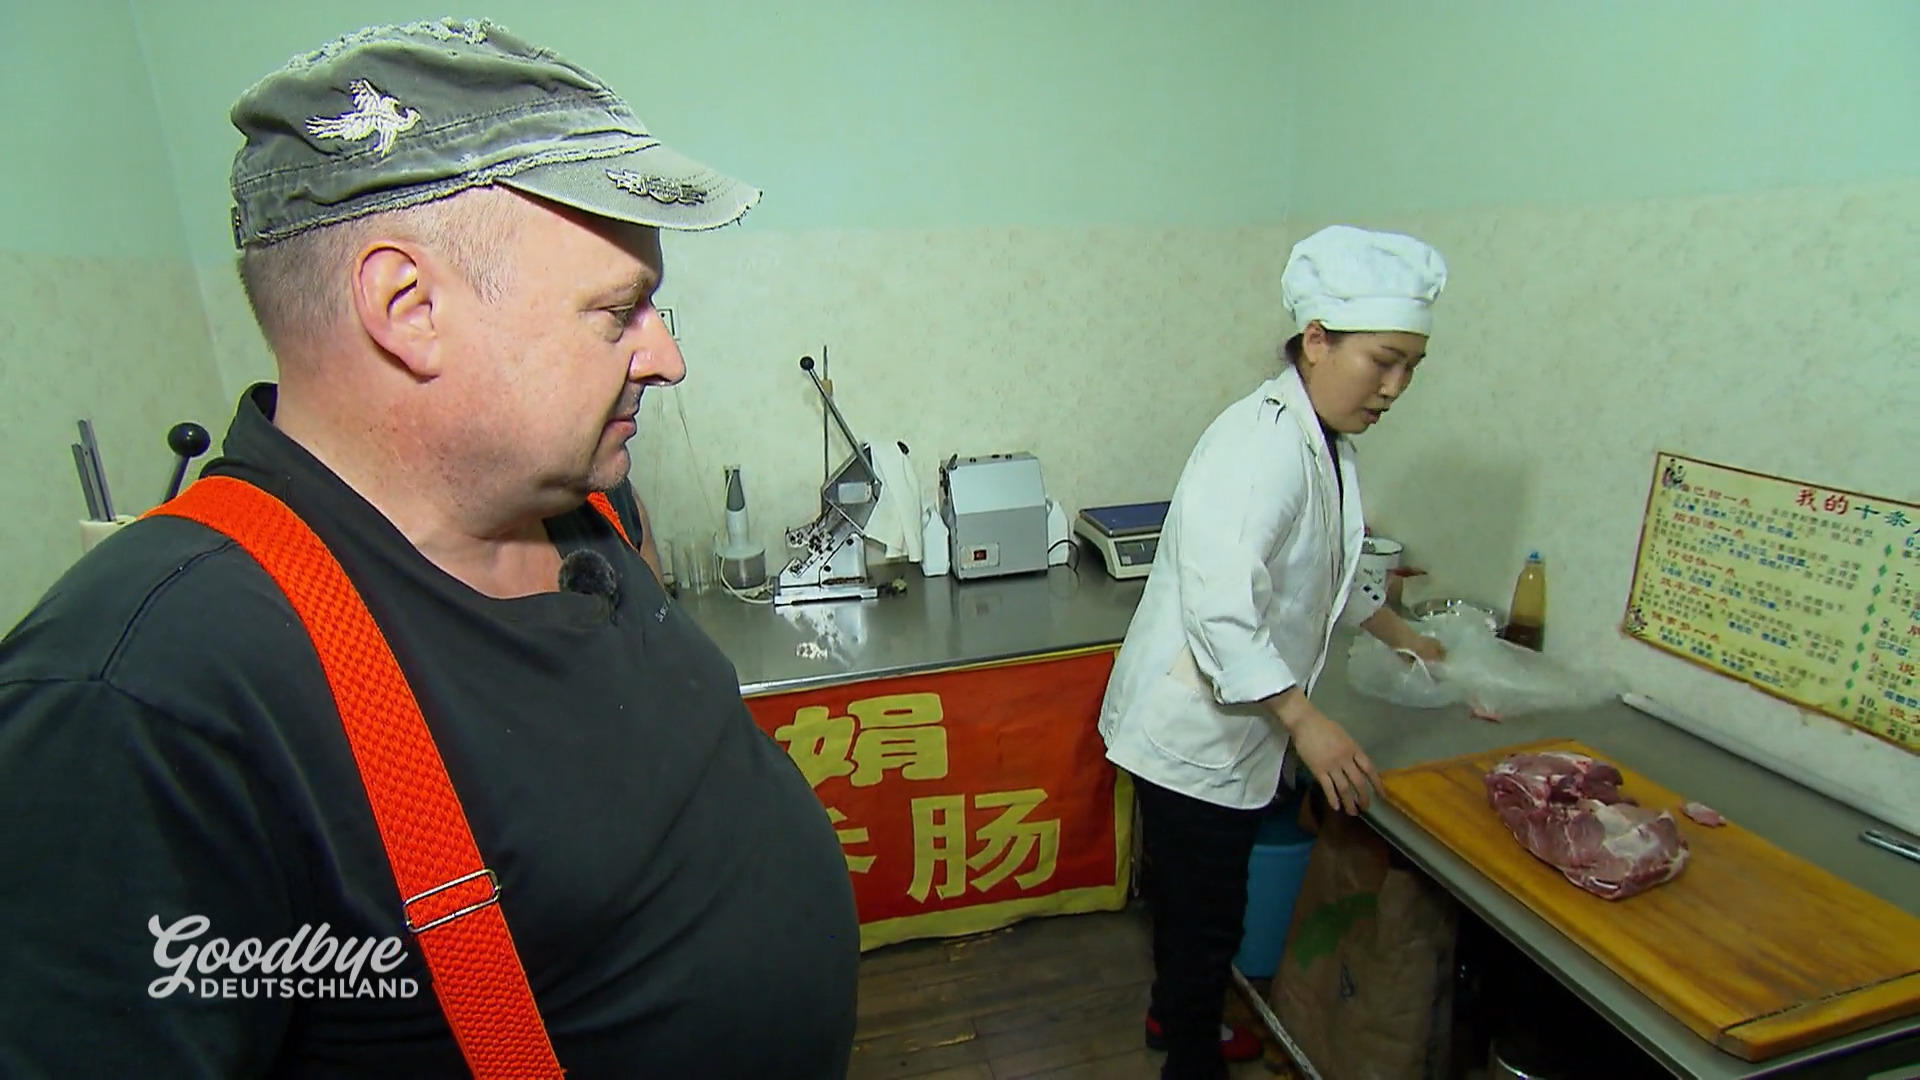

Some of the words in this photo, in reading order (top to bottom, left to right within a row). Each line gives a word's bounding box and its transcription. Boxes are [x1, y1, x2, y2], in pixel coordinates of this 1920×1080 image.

[1796, 488, 1920, 535] 我的十条
[774, 692, 949, 788] 娟
